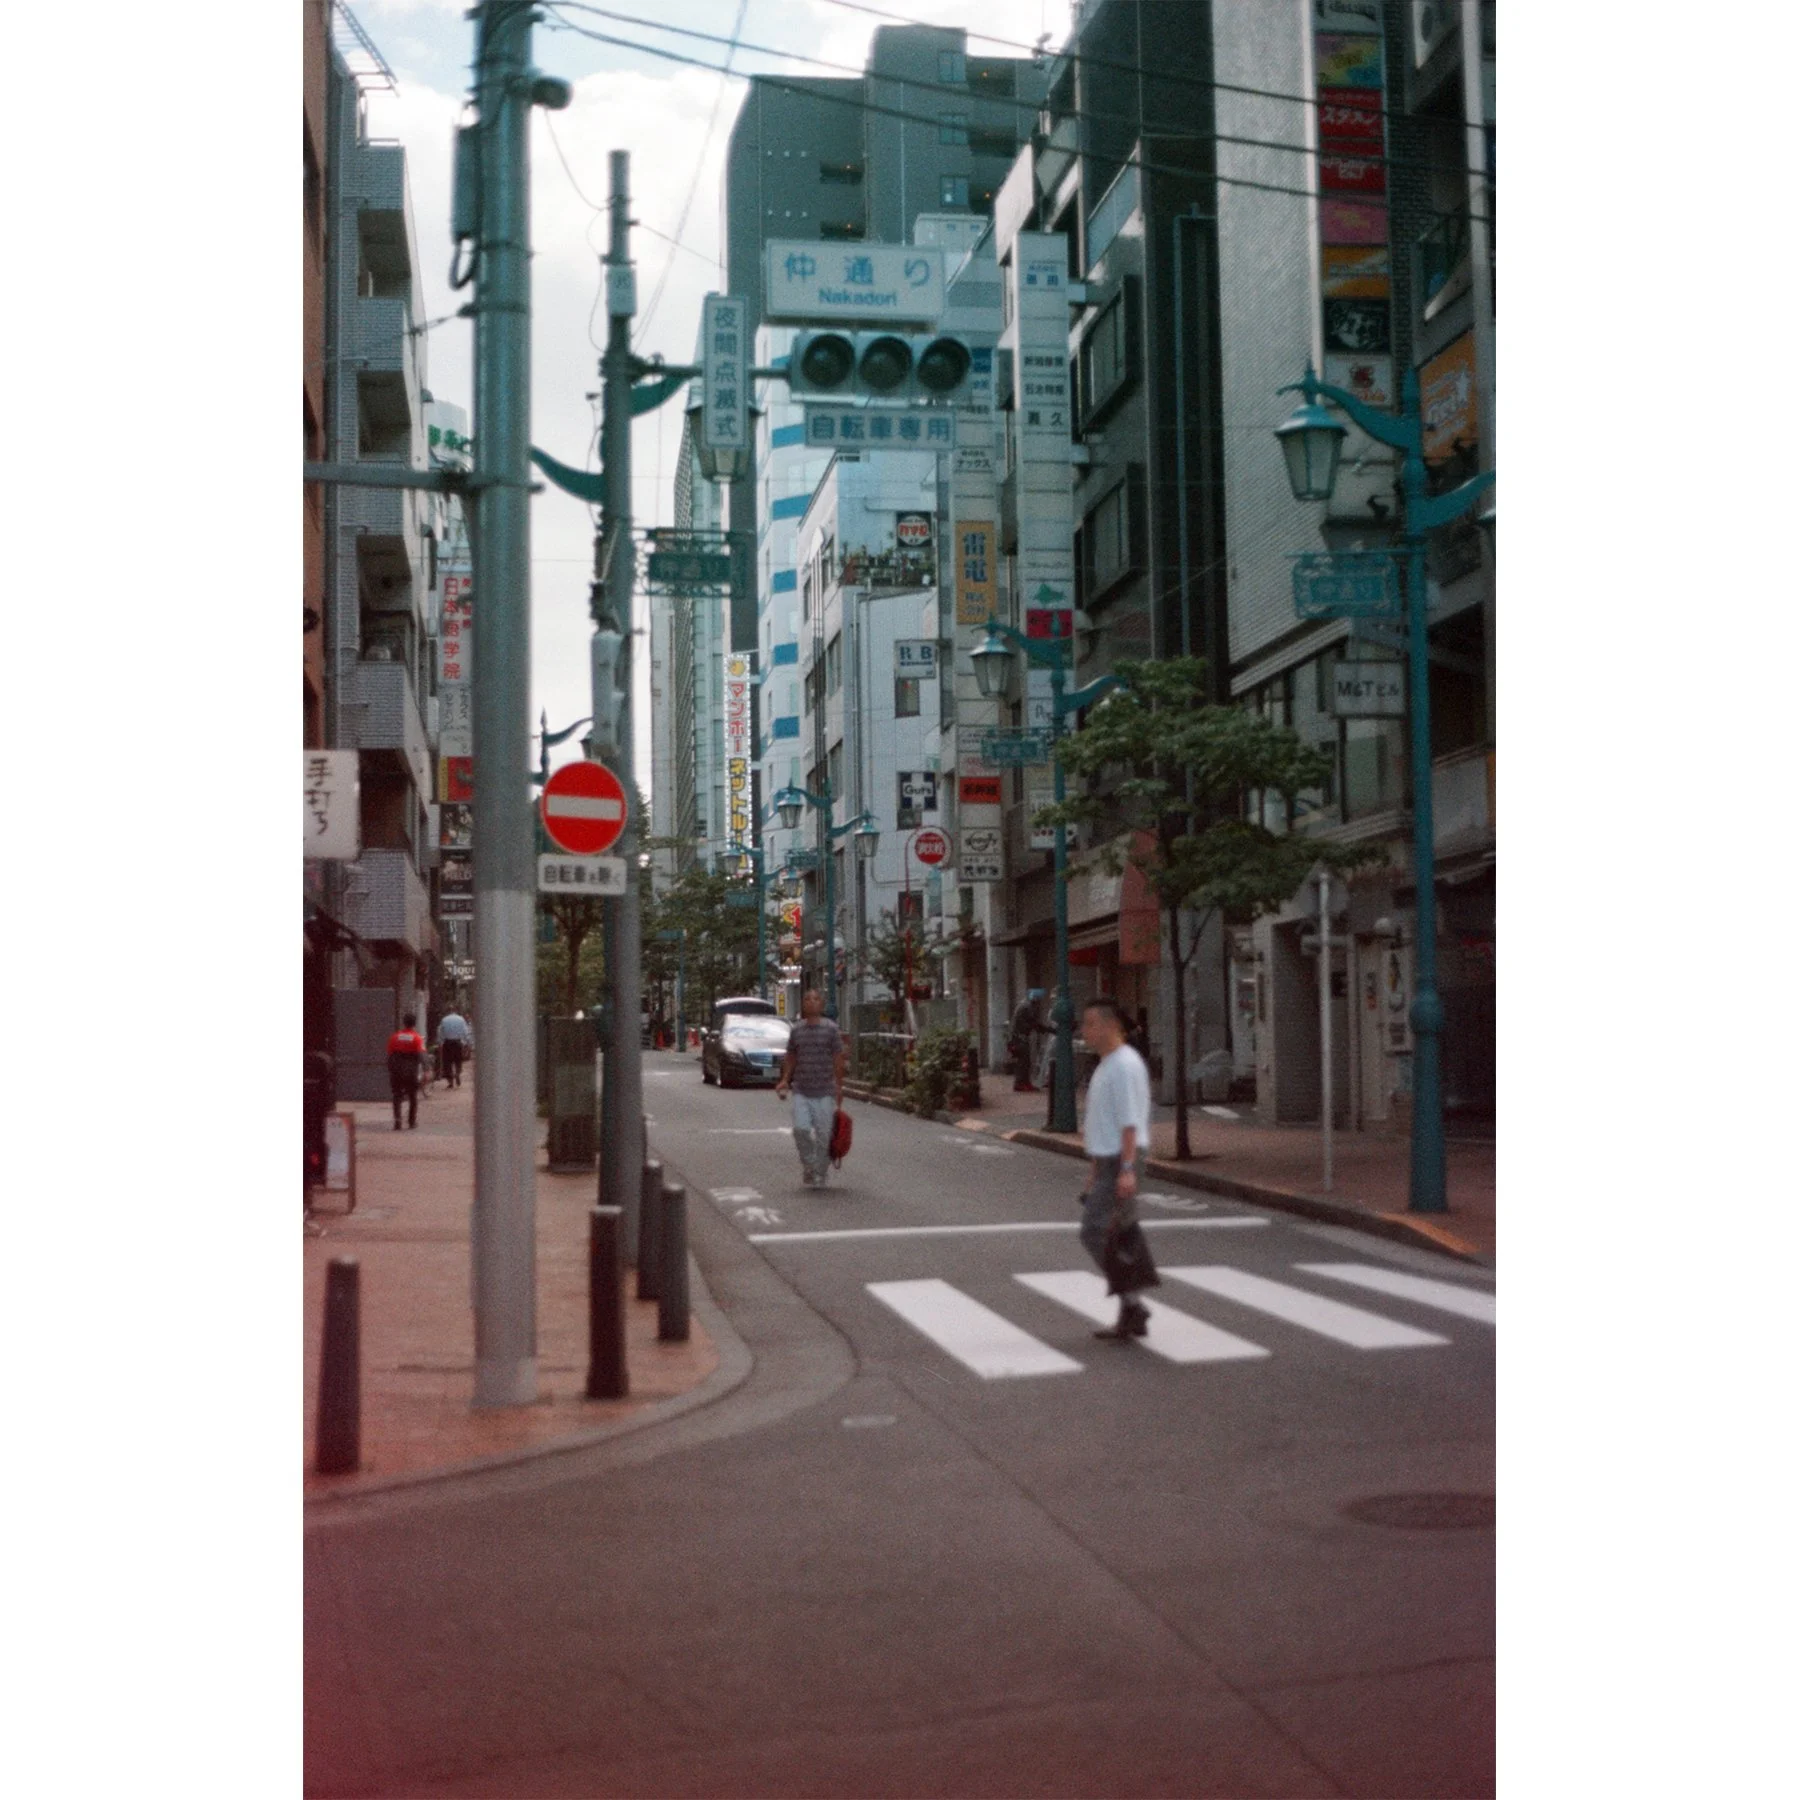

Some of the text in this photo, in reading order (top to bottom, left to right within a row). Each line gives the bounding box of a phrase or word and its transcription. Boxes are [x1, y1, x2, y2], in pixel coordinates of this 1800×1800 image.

[784, 253, 930, 288] 仲通り
[819, 287, 897, 306] Nakadori
[714, 305, 738, 438] 夜間点滅式
[812, 415, 950, 441] 自転車専用
[921, 646, 932, 660] B
